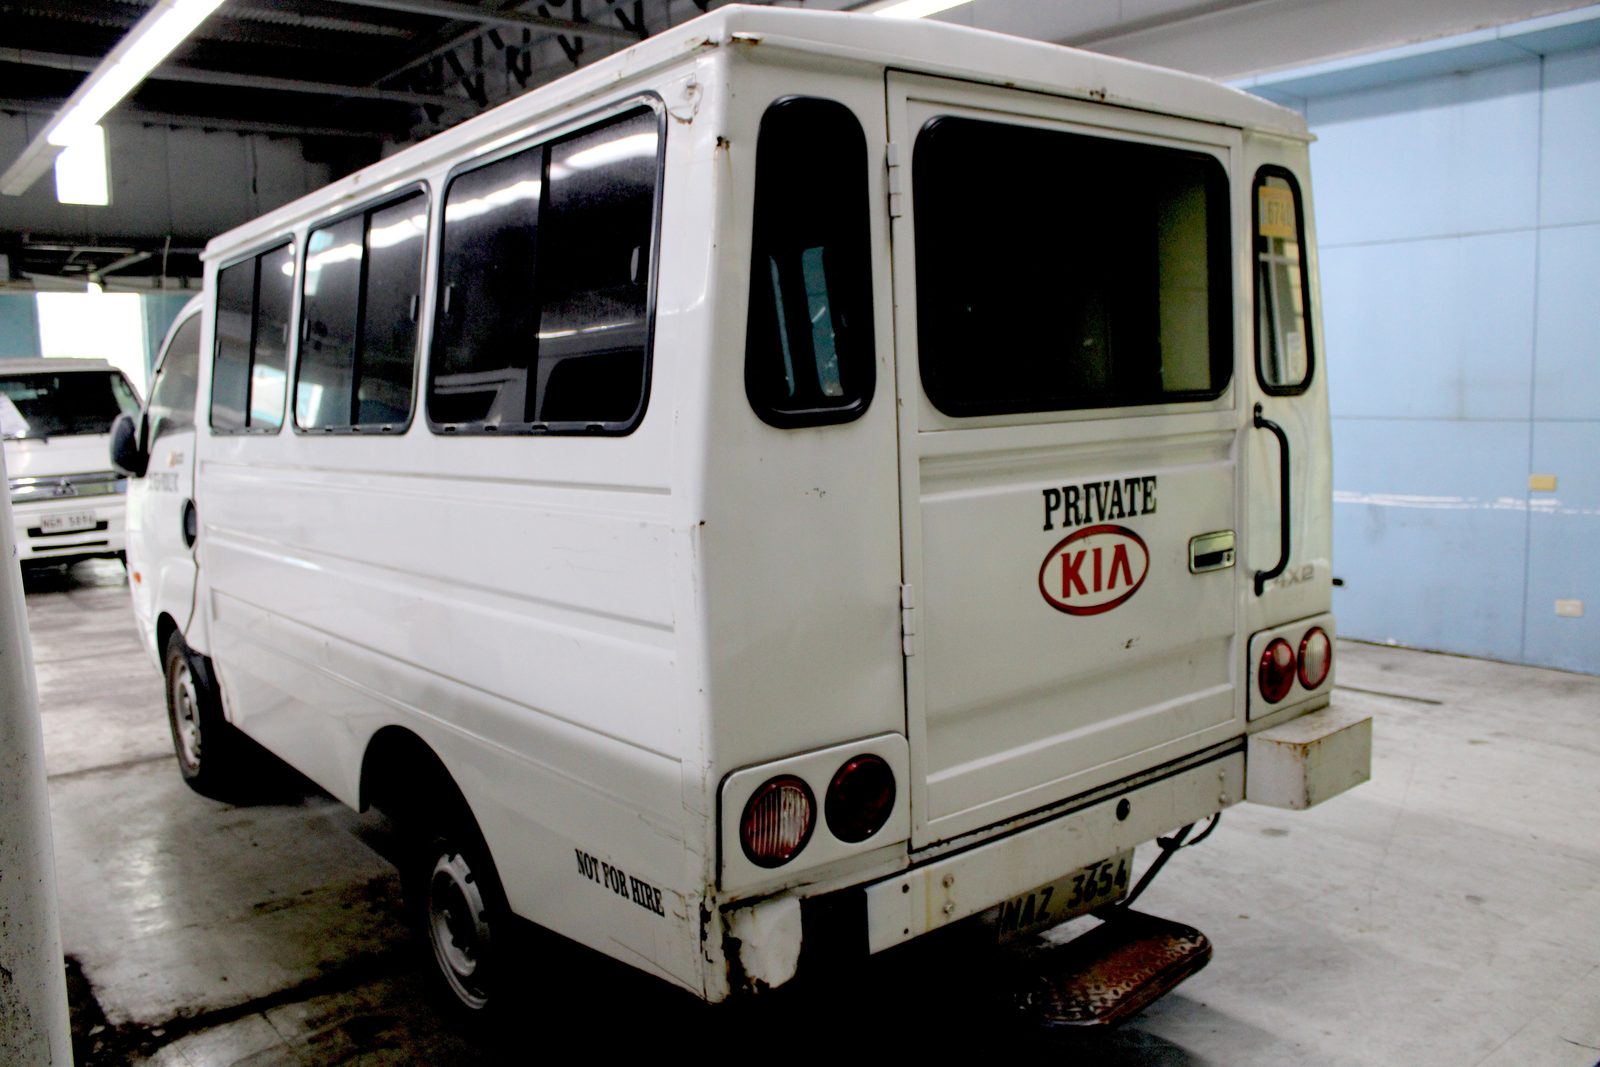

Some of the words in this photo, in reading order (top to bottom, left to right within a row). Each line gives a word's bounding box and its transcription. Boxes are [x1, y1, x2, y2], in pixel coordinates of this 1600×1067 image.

[1043, 475, 1157, 531] PRIVATE
[1061, 543, 1134, 599] KIA
[575, 848, 600, 884] NOT
[601, 862, 629, 900] FOR
[630, 876, 665, 918] HIRE
[1066, 859, 1127, 909] 3654
